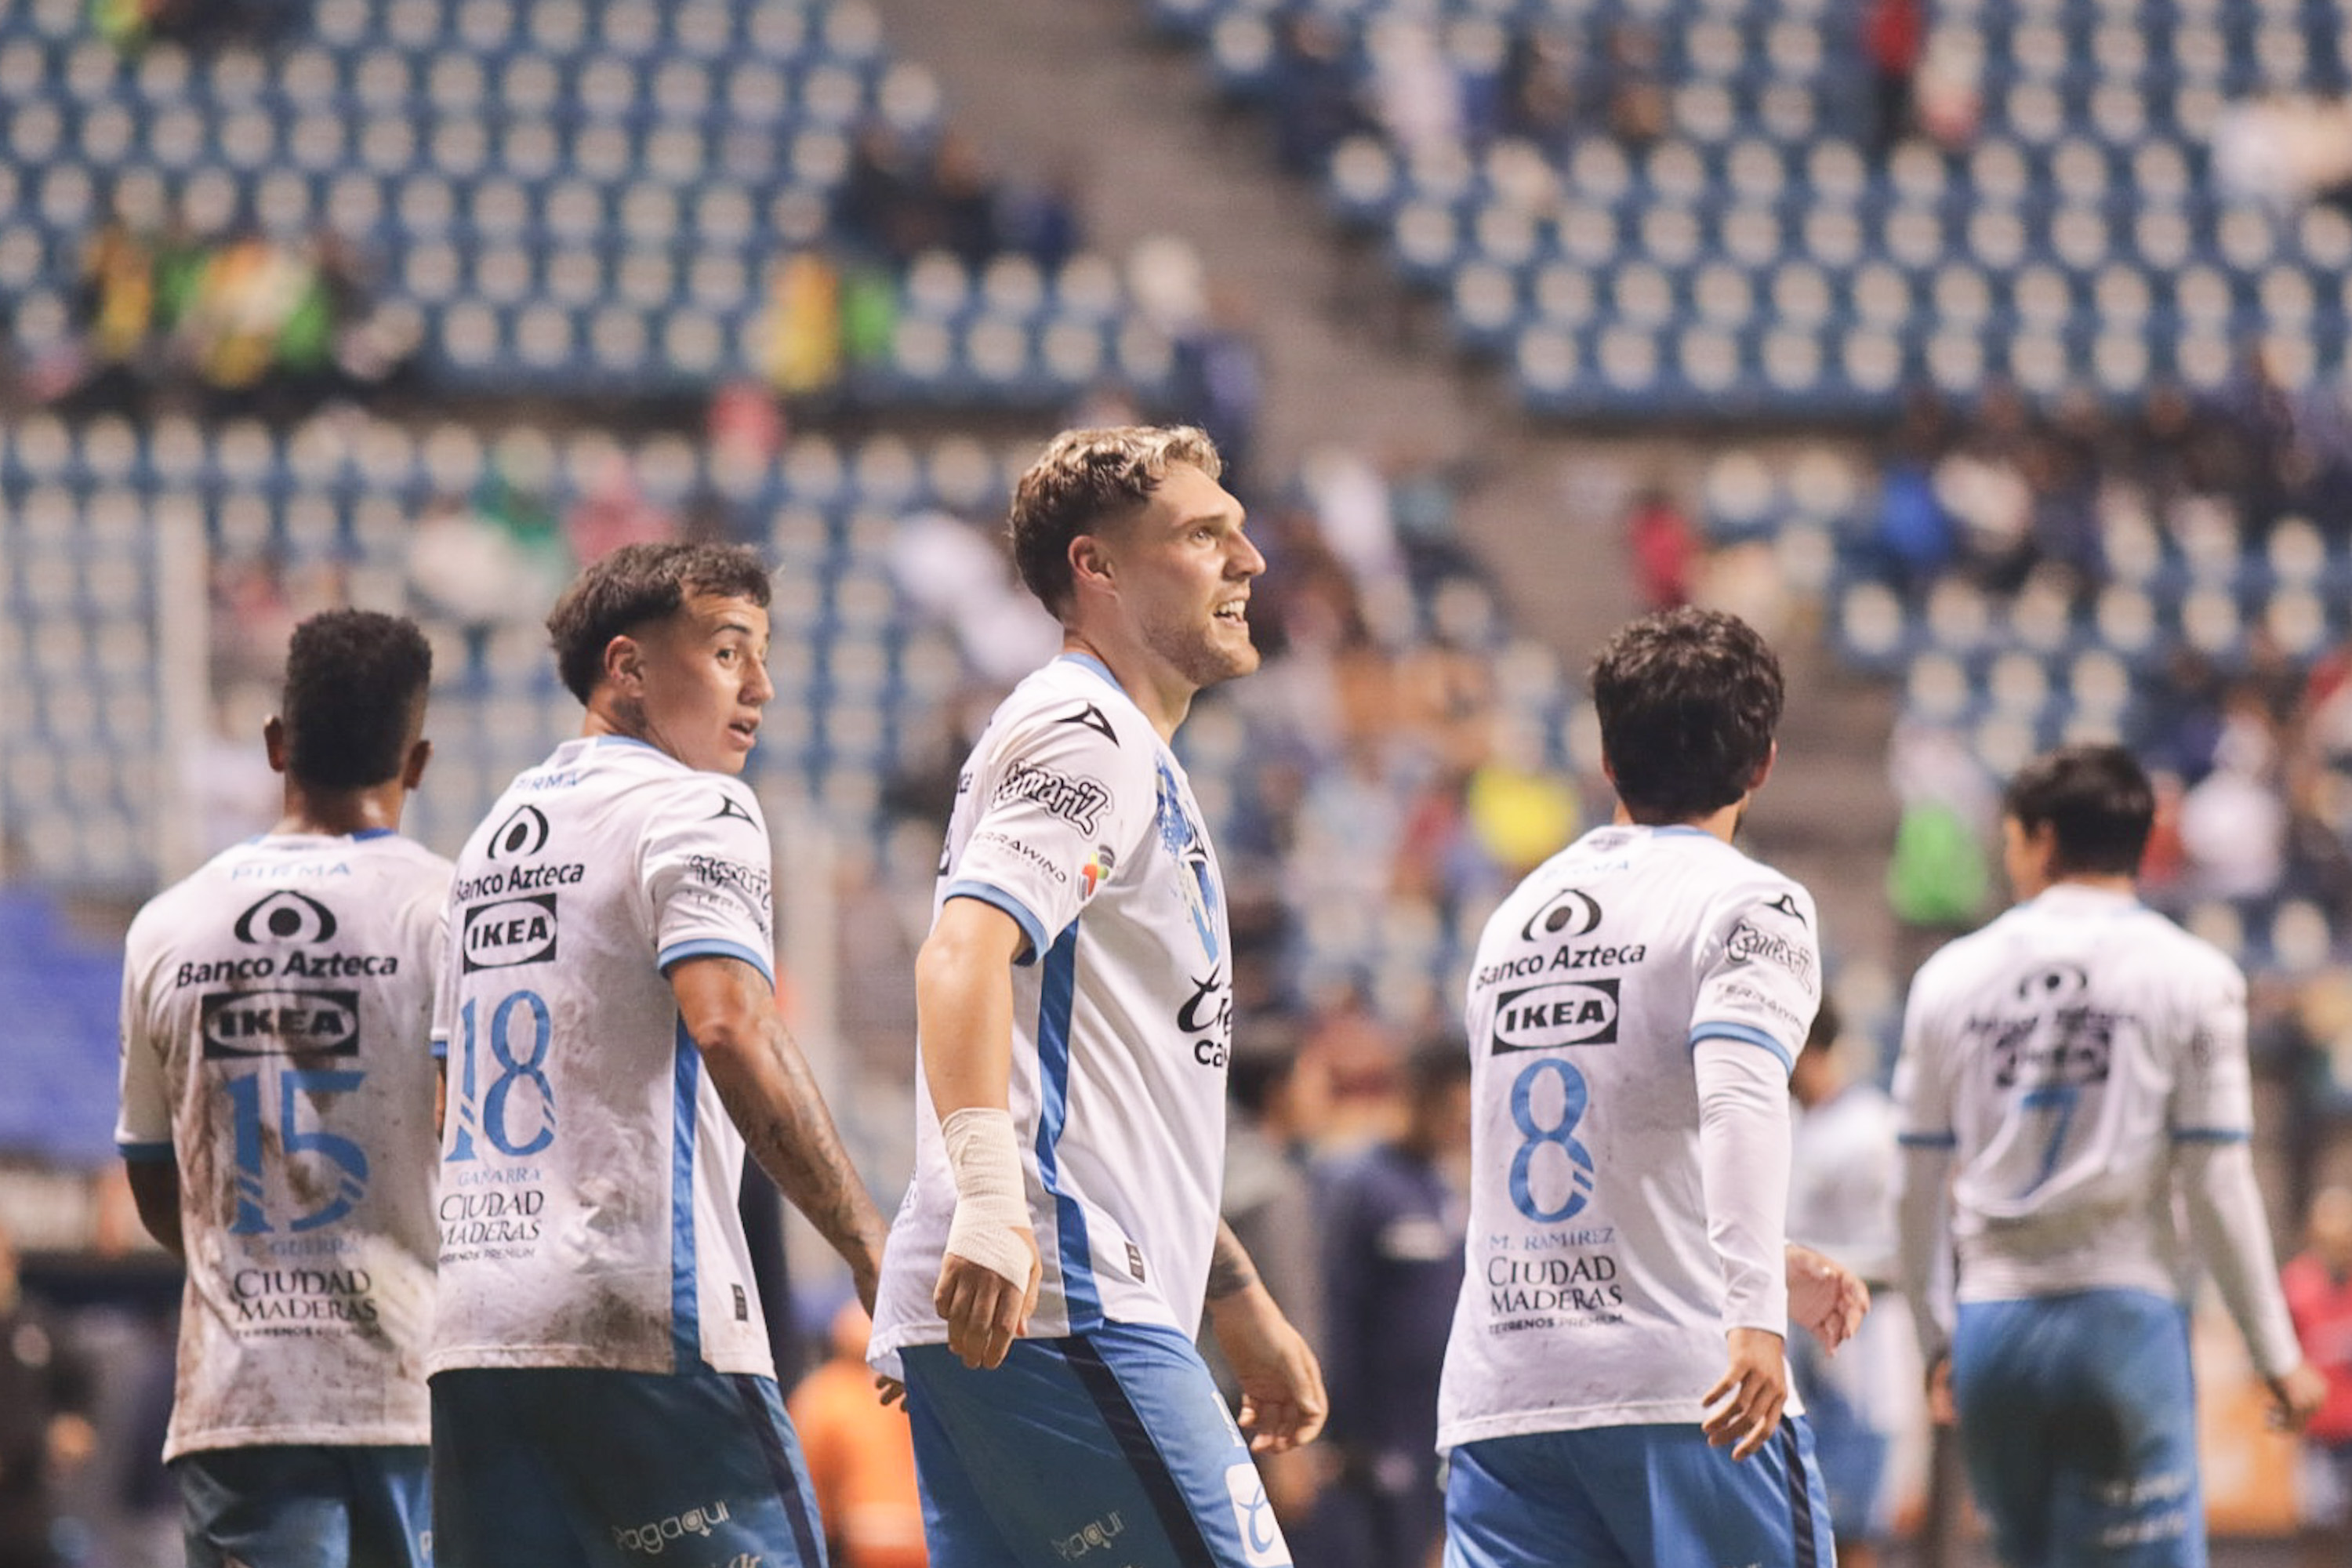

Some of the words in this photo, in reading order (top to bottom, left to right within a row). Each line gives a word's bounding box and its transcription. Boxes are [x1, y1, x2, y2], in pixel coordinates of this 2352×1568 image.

[231, 862, 352, 881] PIRMA
[507, 863, 585, 891] Azteca
[471, 916, 549, 951] IKEA
[176, 956, 274, 989] Banco
[282, 950, 399, 978] Azteca
[1475, 953, 1544, 992] Banco
[1549, 943, 1647, 972] Azteca
[219, 1008, 345, 1037] IKEA
[1504, 999, 1606, 1033] IKEA
[443, 989, 557, 1163] 18
[224, 1069, 369, 1236] 15
[1508, 1057, 1595, 1225] 8
[2020, 1085, 2082, 1202] 7
[440, 1190, 544, 1221] CIUDAD
[1525, 1227, 1616, 1250] RAMIREZ
[234, 1268, 372, 1298] CIUDAD
[1488, 1255, 1617, 1287] CIUDAD
[237, 1297, 379, 1323] MADERAS
[1490, 1283, 1624, 1318] MADERAS
[1490, 1317, 1555, 1335] TERRENOS
